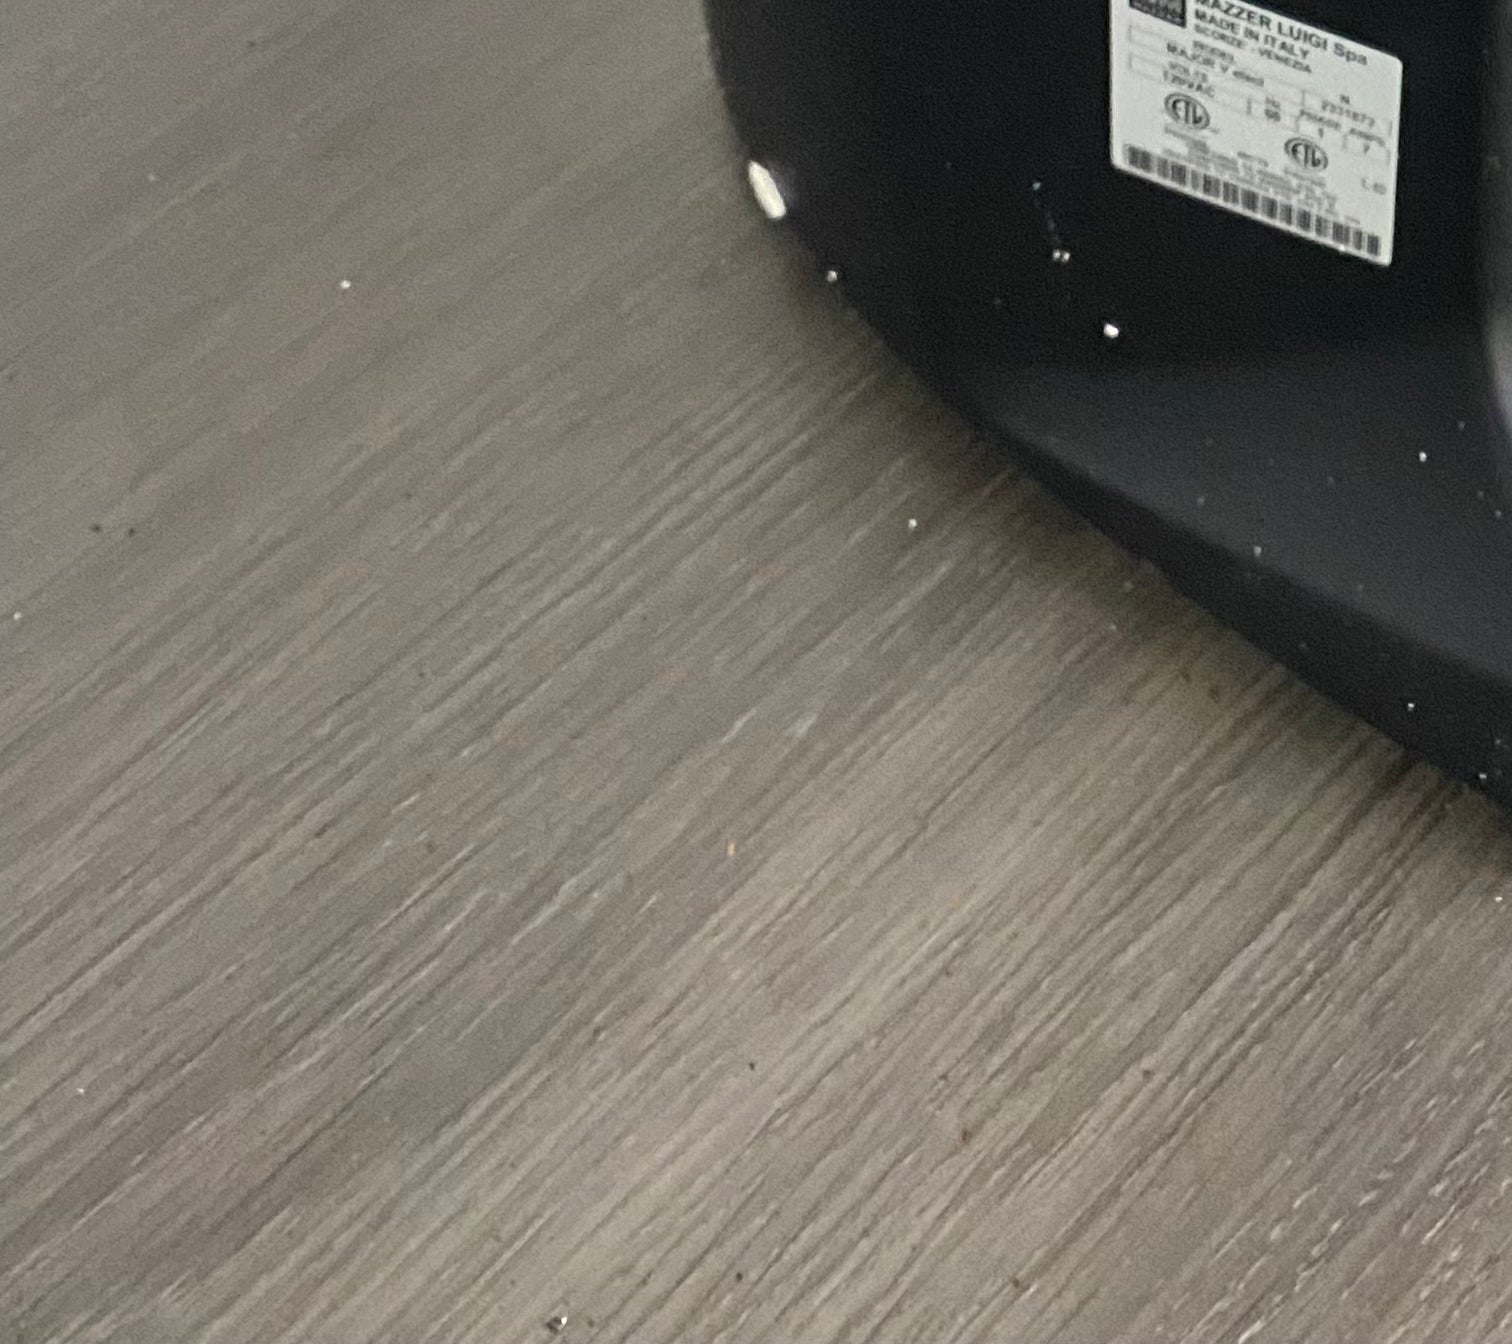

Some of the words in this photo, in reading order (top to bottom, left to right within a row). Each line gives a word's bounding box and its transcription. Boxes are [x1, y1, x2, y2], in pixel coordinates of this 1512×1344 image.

[1194, 9, 1242, 36] MADE
[1264, 34, 1311, 60] ITALY
[1277, 21, 1329, 51] LUIGI
[1333, 42, 1368, 66] Spa
